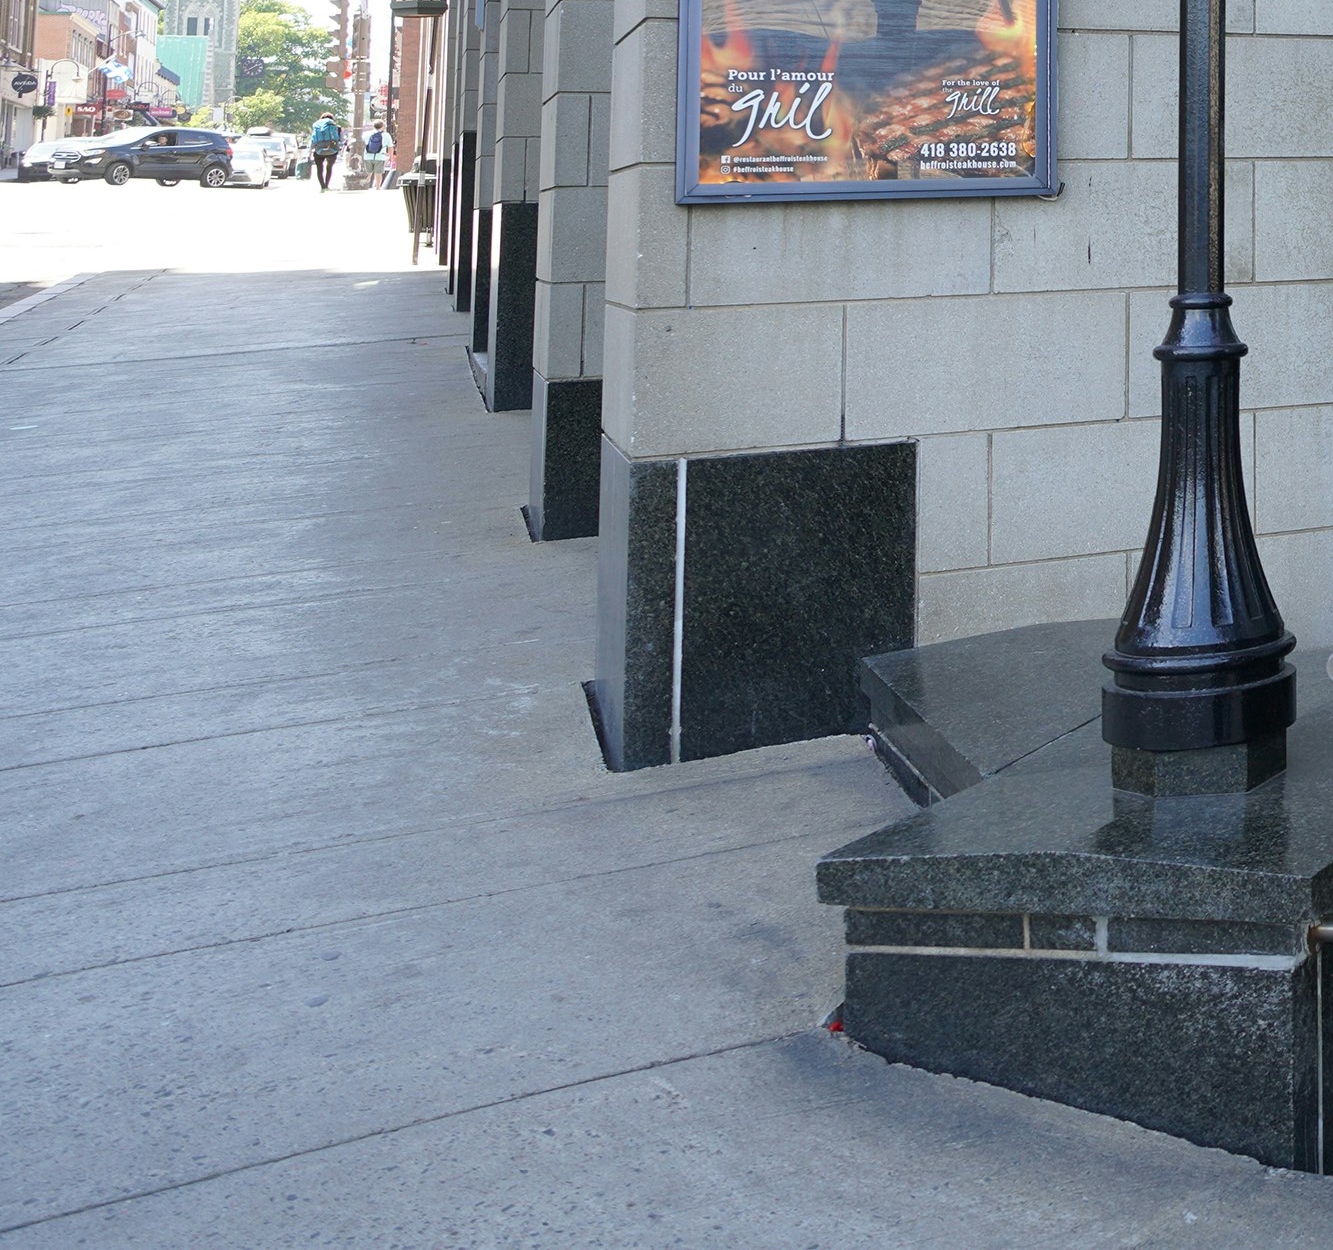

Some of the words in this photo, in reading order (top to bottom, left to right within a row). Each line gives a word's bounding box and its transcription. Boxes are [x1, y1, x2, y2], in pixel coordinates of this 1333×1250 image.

[728, 69, 766, 81] Pour
[770, 68, 835, 81] l'amour
[728, 83, 743, 93] du
[945, 86, 1000, 119] grill
[731, 82, 833, 147] gril
[920, 143, 945, 157] 418
[949, 142, 1017, 157] 380-2638
[733, 155, 828, 163] @restaurantbeffroisteakhouse
[920, 159, 1017, 170] beffroisteakhouse.com
[733, 165, 794, 173] #beffroisteakhouse
